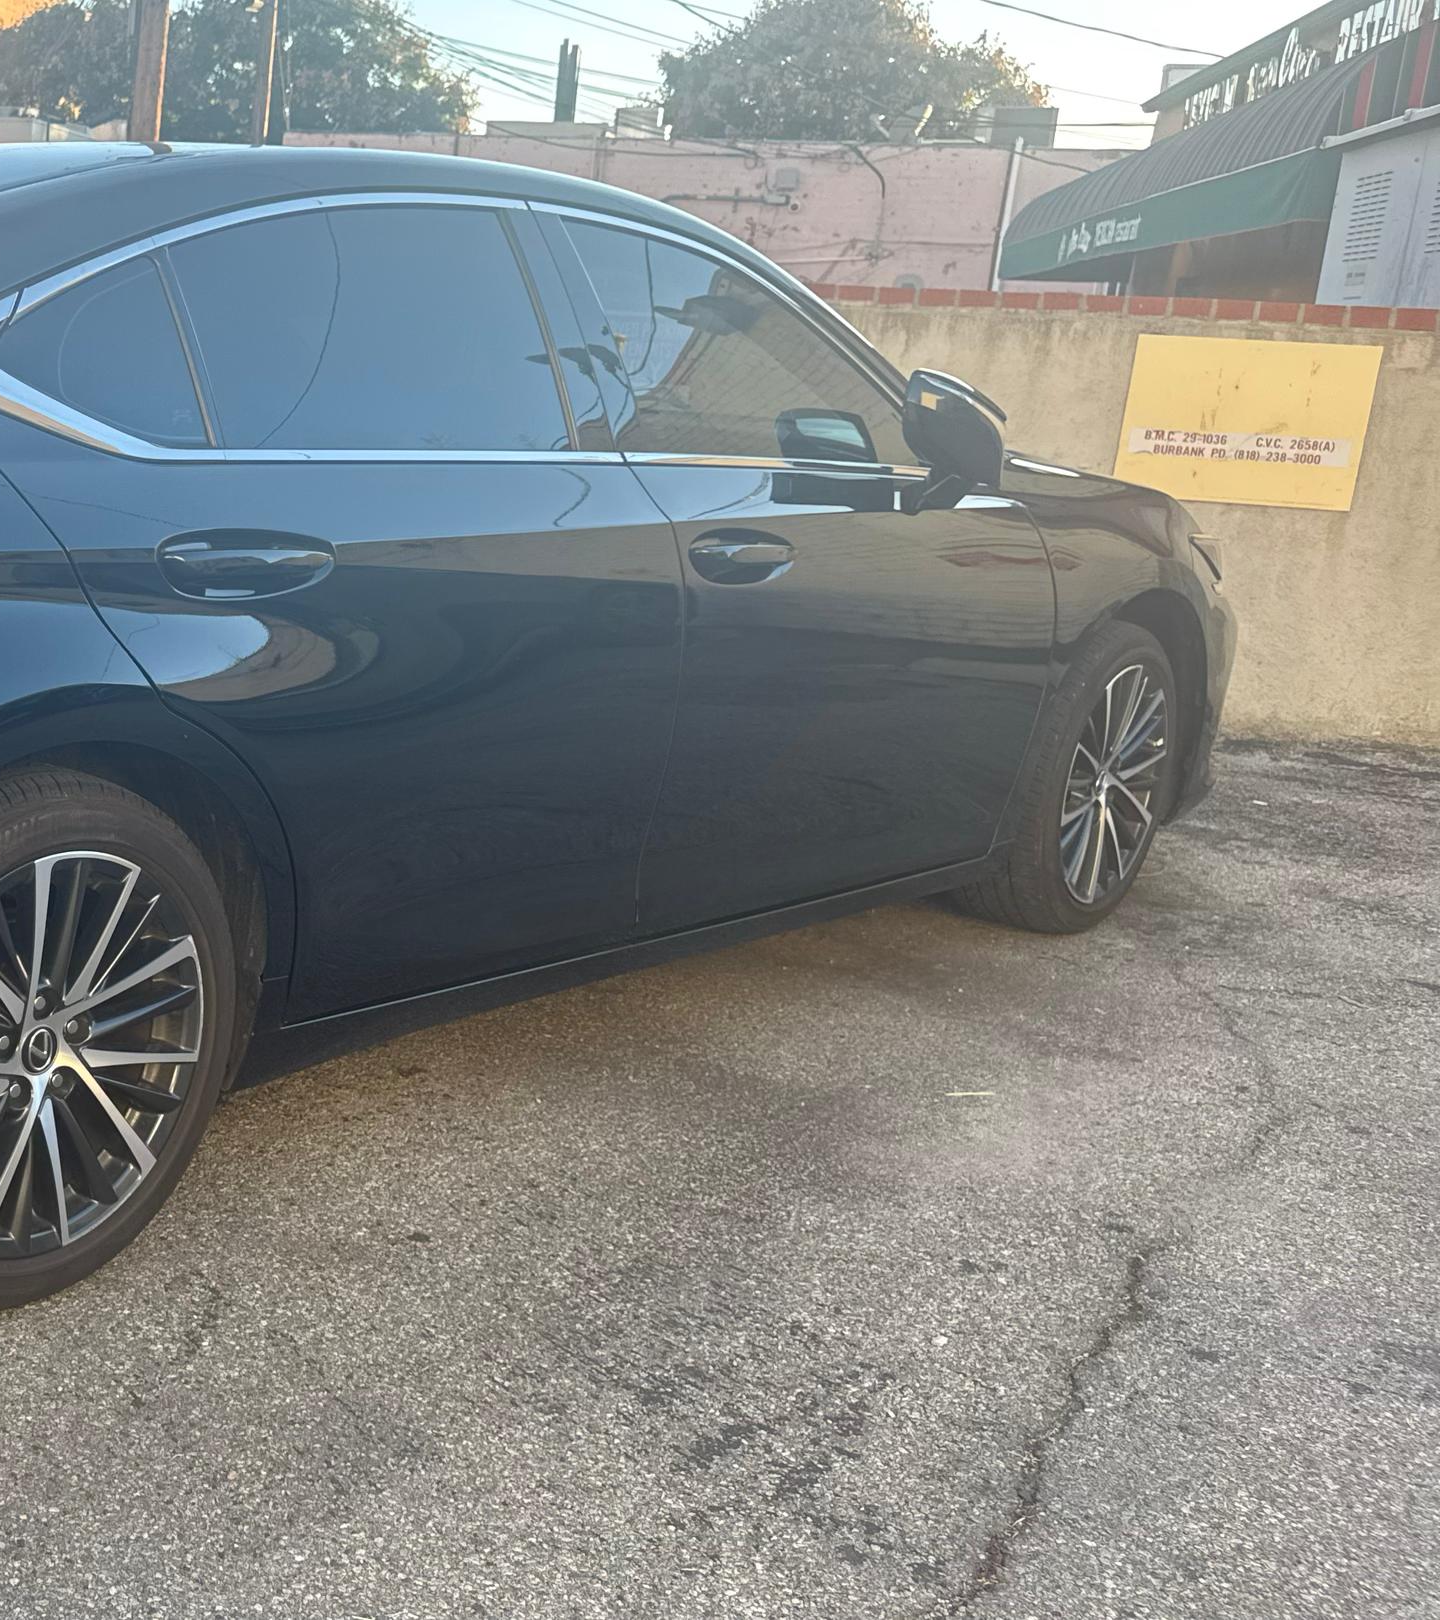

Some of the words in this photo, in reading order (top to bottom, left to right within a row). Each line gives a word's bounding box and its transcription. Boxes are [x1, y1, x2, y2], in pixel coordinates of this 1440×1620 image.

[1144, 429, 1177, 443] B.M.C.
[1183, 432, 1227, 446] 29-1036
[1255, 437, 1283, 450] C.V.C.
[1289, 439, 1336, 453] 2658(A)
[1152, 443, 1205, 458] BURBANK
[1234, 448, 1260, 462] (818)
[1265, 451, 1322, 466] 238-3000
